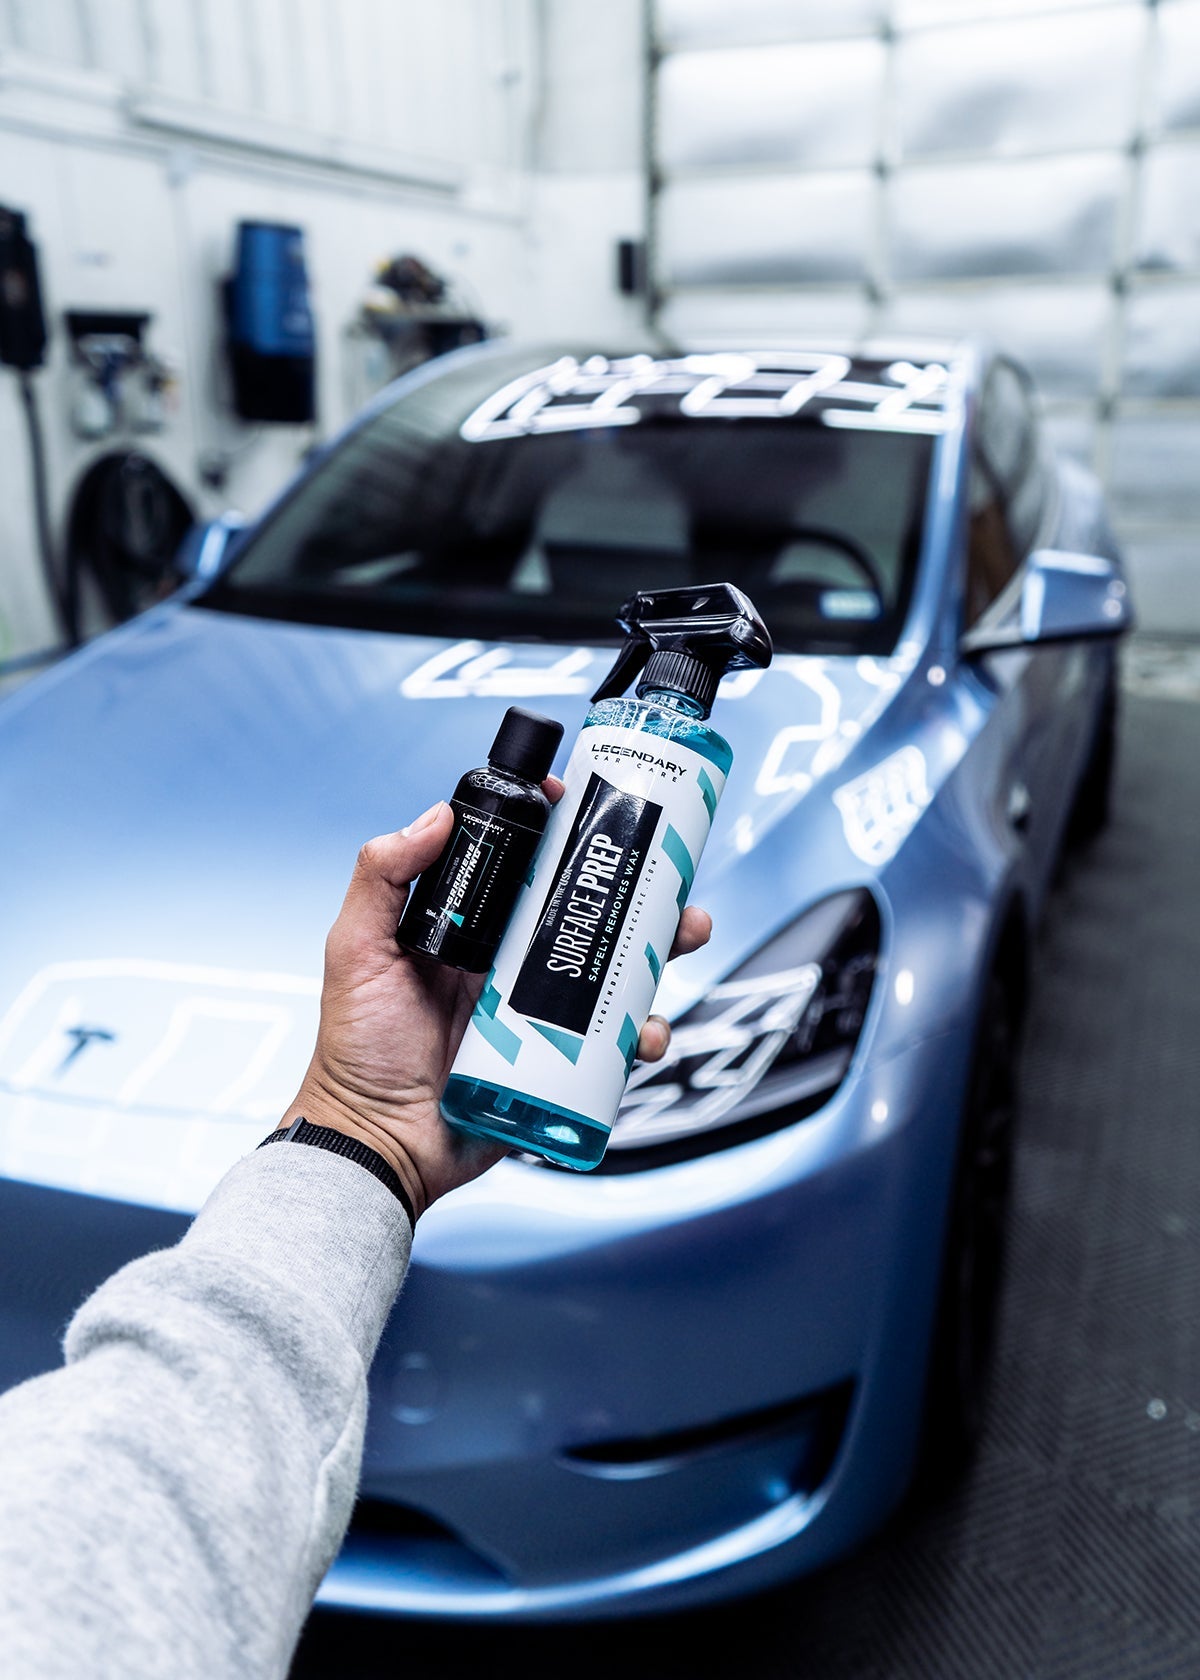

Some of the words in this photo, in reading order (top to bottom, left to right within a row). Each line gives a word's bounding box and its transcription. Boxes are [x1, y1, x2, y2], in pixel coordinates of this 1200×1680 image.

[592, 744, 687, 776] LEGENDARY
[594, 754, 621, 763] CAR
[636, 763, 677, 782] CARE
[446, 843, 475, 905] GRAPHENE
[453, 847, 481, 908] COATING
[559, 867, 573, 887] USA
[576, 833, 624, 894] PREP
[552, 899, 561, 908] IN
[555, 884, 566, 899] THE
[545, 908, 558, 927] MADE
[547, 890, 606, 978] SURFACE
[588, 937, 610, 982] SAFELY
[605, 879, 630, 934] REMOVES
[624, 849, 640, 877] WAX
[594, 859, 657, 1033] LEGENDARYCARCARE.COM
